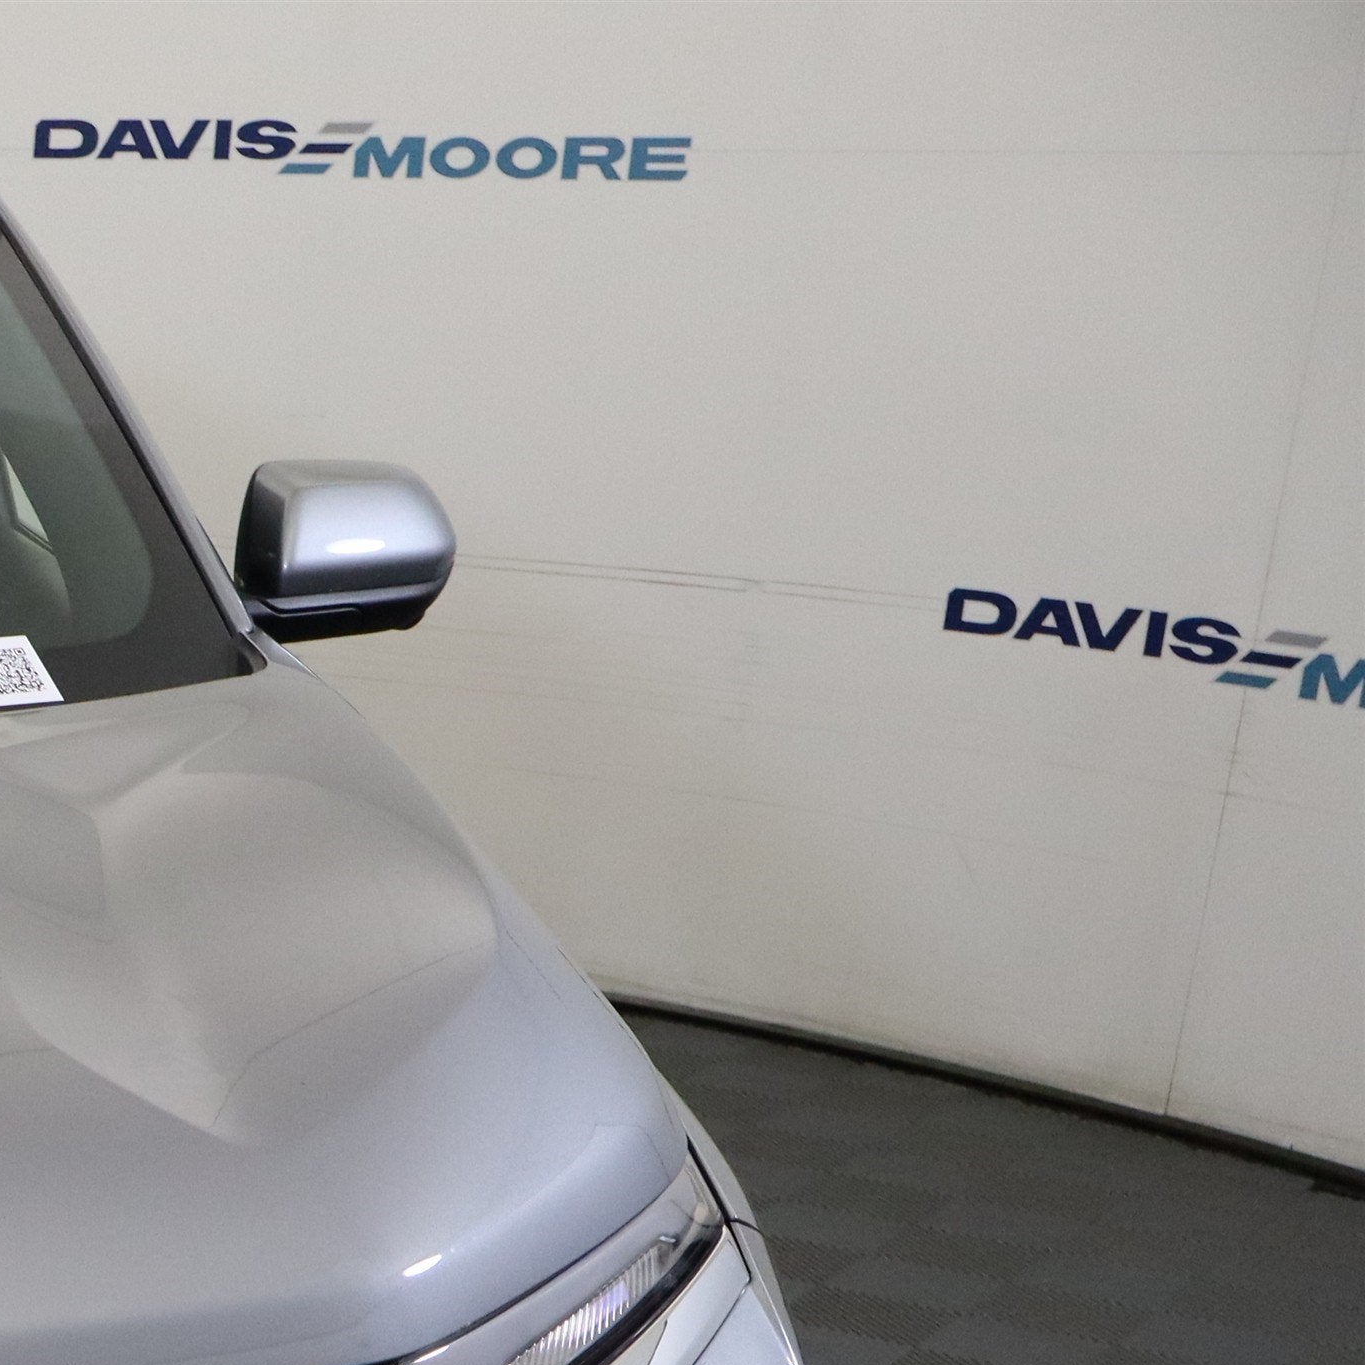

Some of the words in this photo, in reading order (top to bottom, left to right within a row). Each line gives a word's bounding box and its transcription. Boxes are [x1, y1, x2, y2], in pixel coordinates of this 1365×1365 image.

[33, 119, 298, 160] DAVIS
[353, 135, 692, 181] MOORE
[943, 587, 1242, 665] DAVIS
